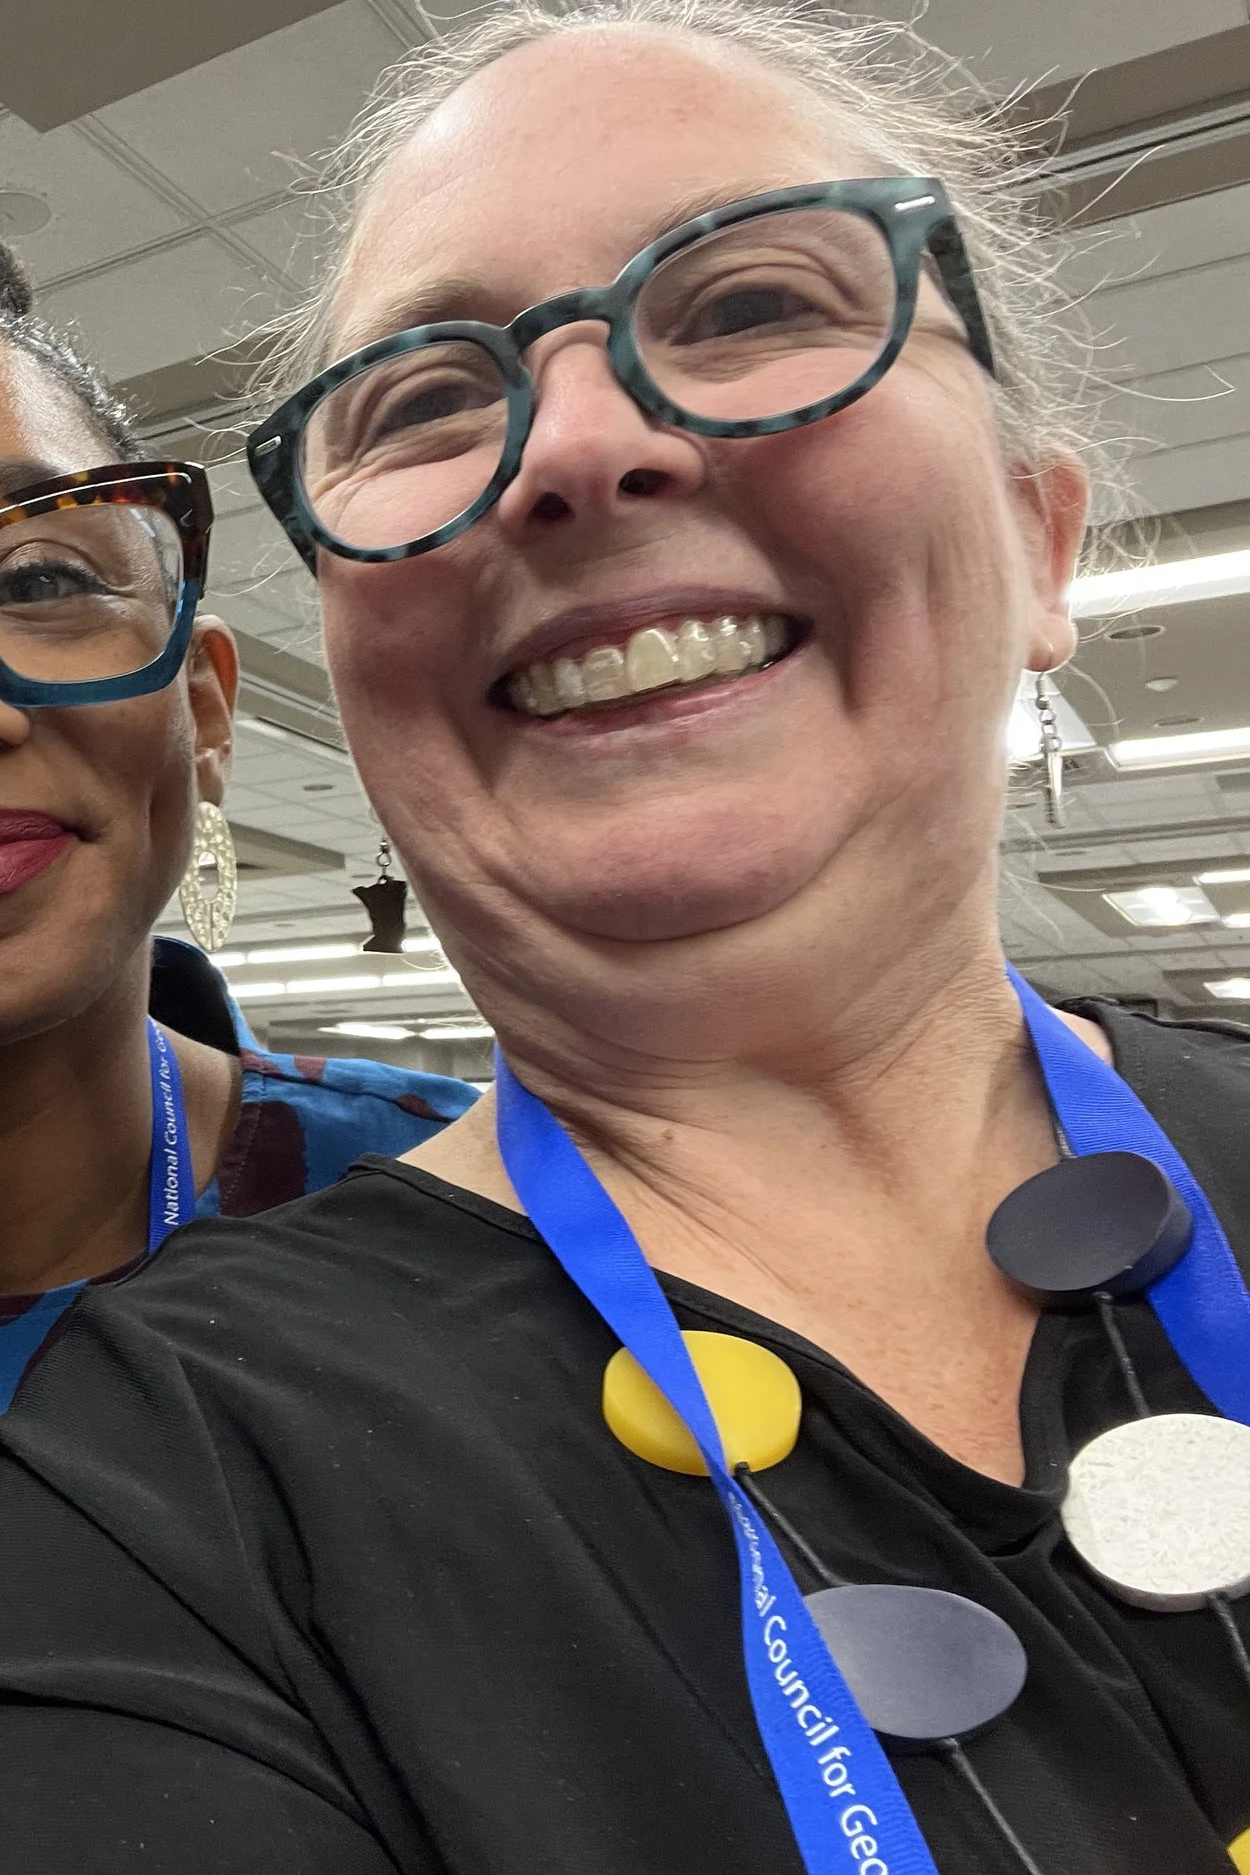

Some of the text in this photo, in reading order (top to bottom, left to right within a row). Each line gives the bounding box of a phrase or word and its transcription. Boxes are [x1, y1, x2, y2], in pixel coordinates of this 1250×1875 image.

[164, 1148, 179, 1226] National
[763, 1615, 840, 1746] Council
[818, 1746, 856, 1798] for
